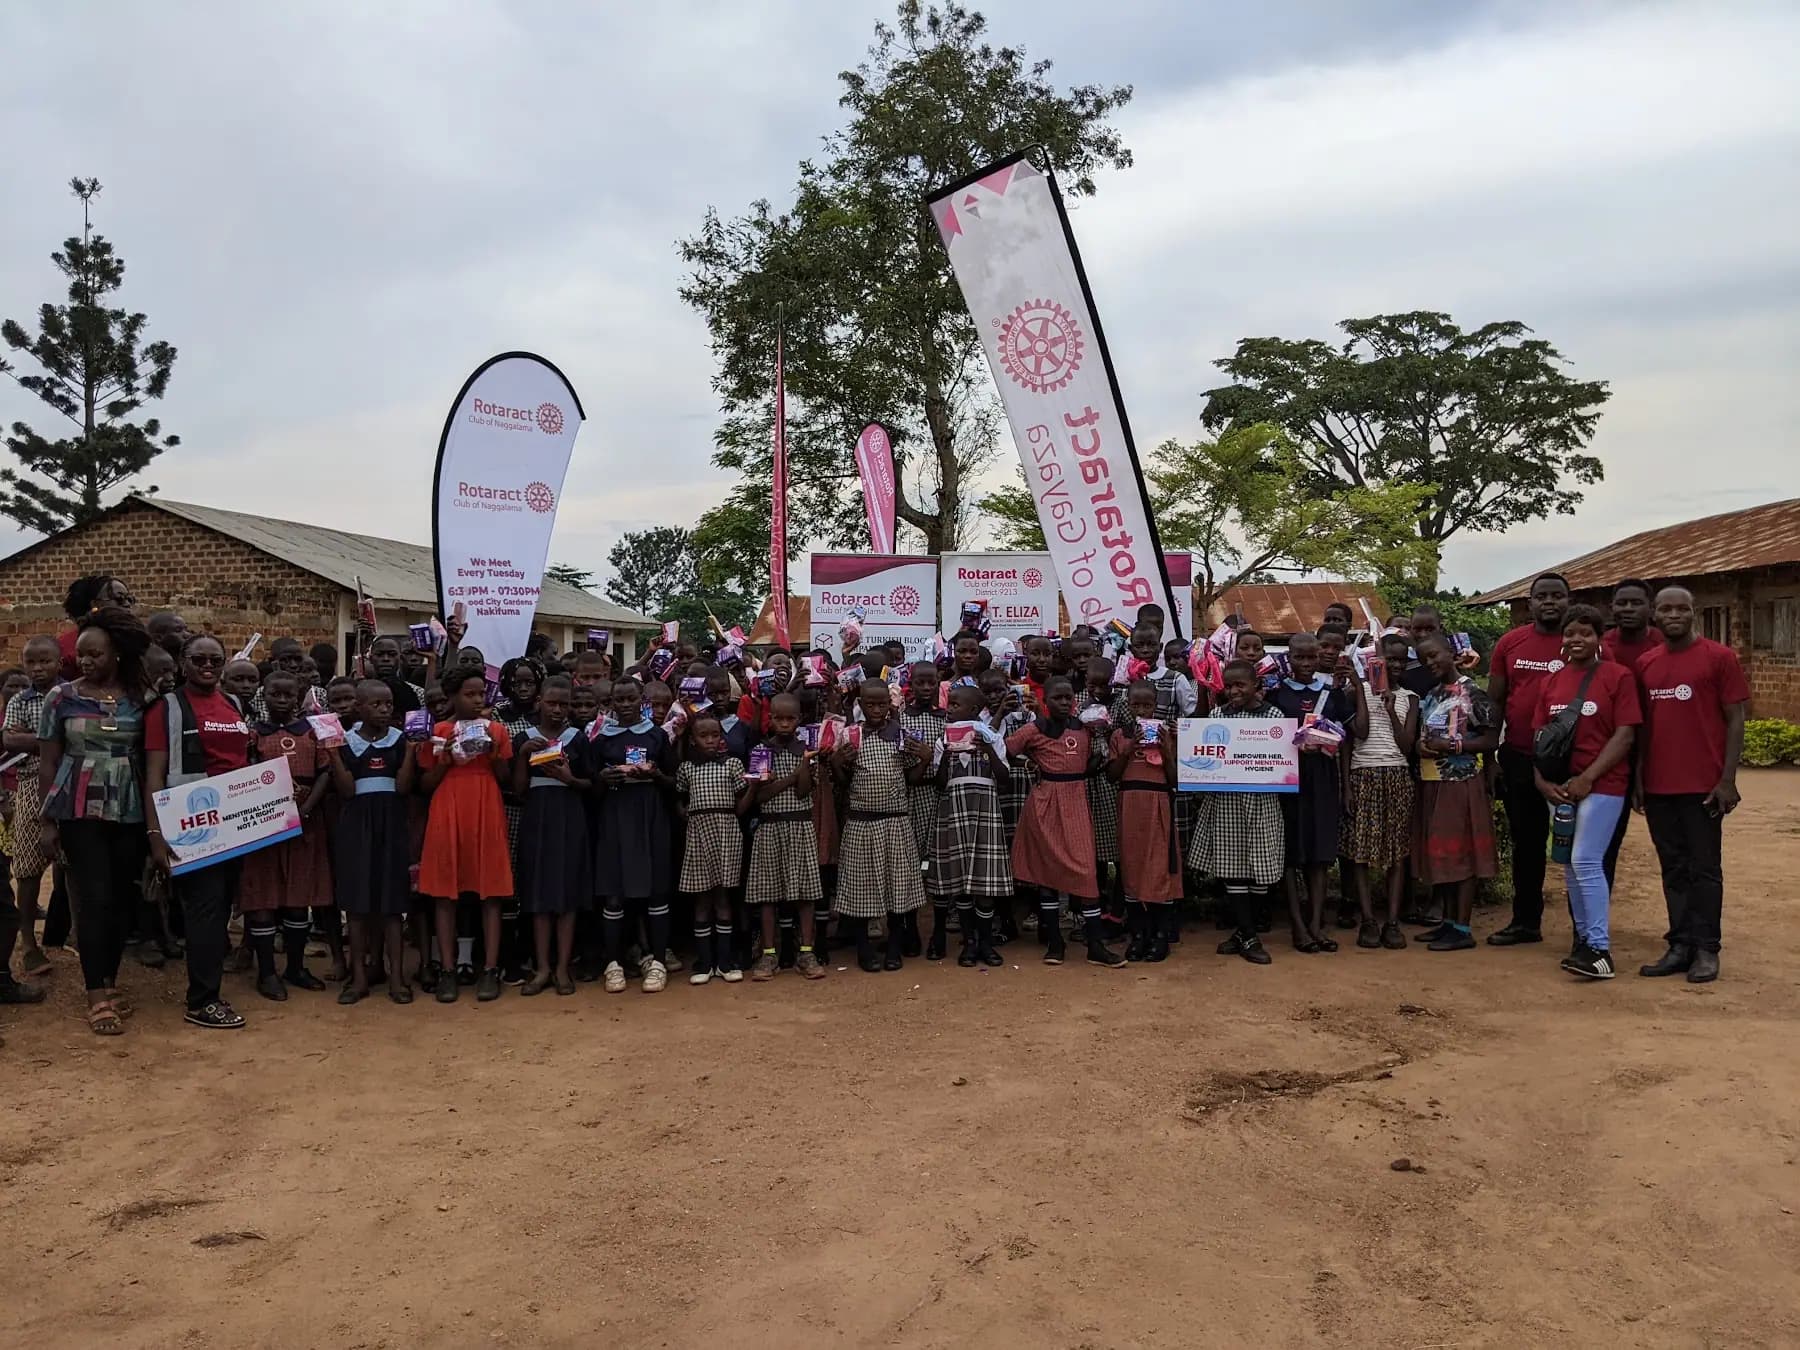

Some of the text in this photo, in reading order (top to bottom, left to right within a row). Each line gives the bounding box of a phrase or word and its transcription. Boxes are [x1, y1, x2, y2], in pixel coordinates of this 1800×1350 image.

[473, 398, 533, 422] Rotaract
[468, 416, 485, 425] Club
[486, 418, 493, 426] of
[458, 482, 522, 501] Rotaract
[453, 499, 471, 507] Club
[472, 500, 480, 509] of
[470, 558, 512, 567] We Meet
[457, 568, 525, 579] Every Tuesday
[958, 567, 1018, 580] Rotaract
[964, 580, 980, 588] Club
[981, 580, 989, 588] of
[498, 586, 541, 596] 07:30PM
[975, 588, 1018, 596] District 9213
[486, 598, 501, 606] City
[503, 598, 533, 606] Gardens
[821, 591, 886, 606] Rotaract
[476, 607, 521, 616] Nakifuma
[815, 606, 833, 614] Club
[834, 606, 843, 614] of
[1006, 606, 1040, 618] ELIZA
[1515, 658, 1548, 667] Rotaract
[204, 720, 238, 729] Rotaract
[1239, 728, 1268, 736] Rotaract
[1193, 745, 1226, 759] HER
[228, 778, 260, 791] Rotaract
[222, 795, 290, 822] MENSTRUAL HYGIENE
[255, 807, 275, 818] RIGHT
[180, 809, 220, 831] HER
[237, 822, 251, 831] NOT
[260, 810, 285, 824] LUXURY
